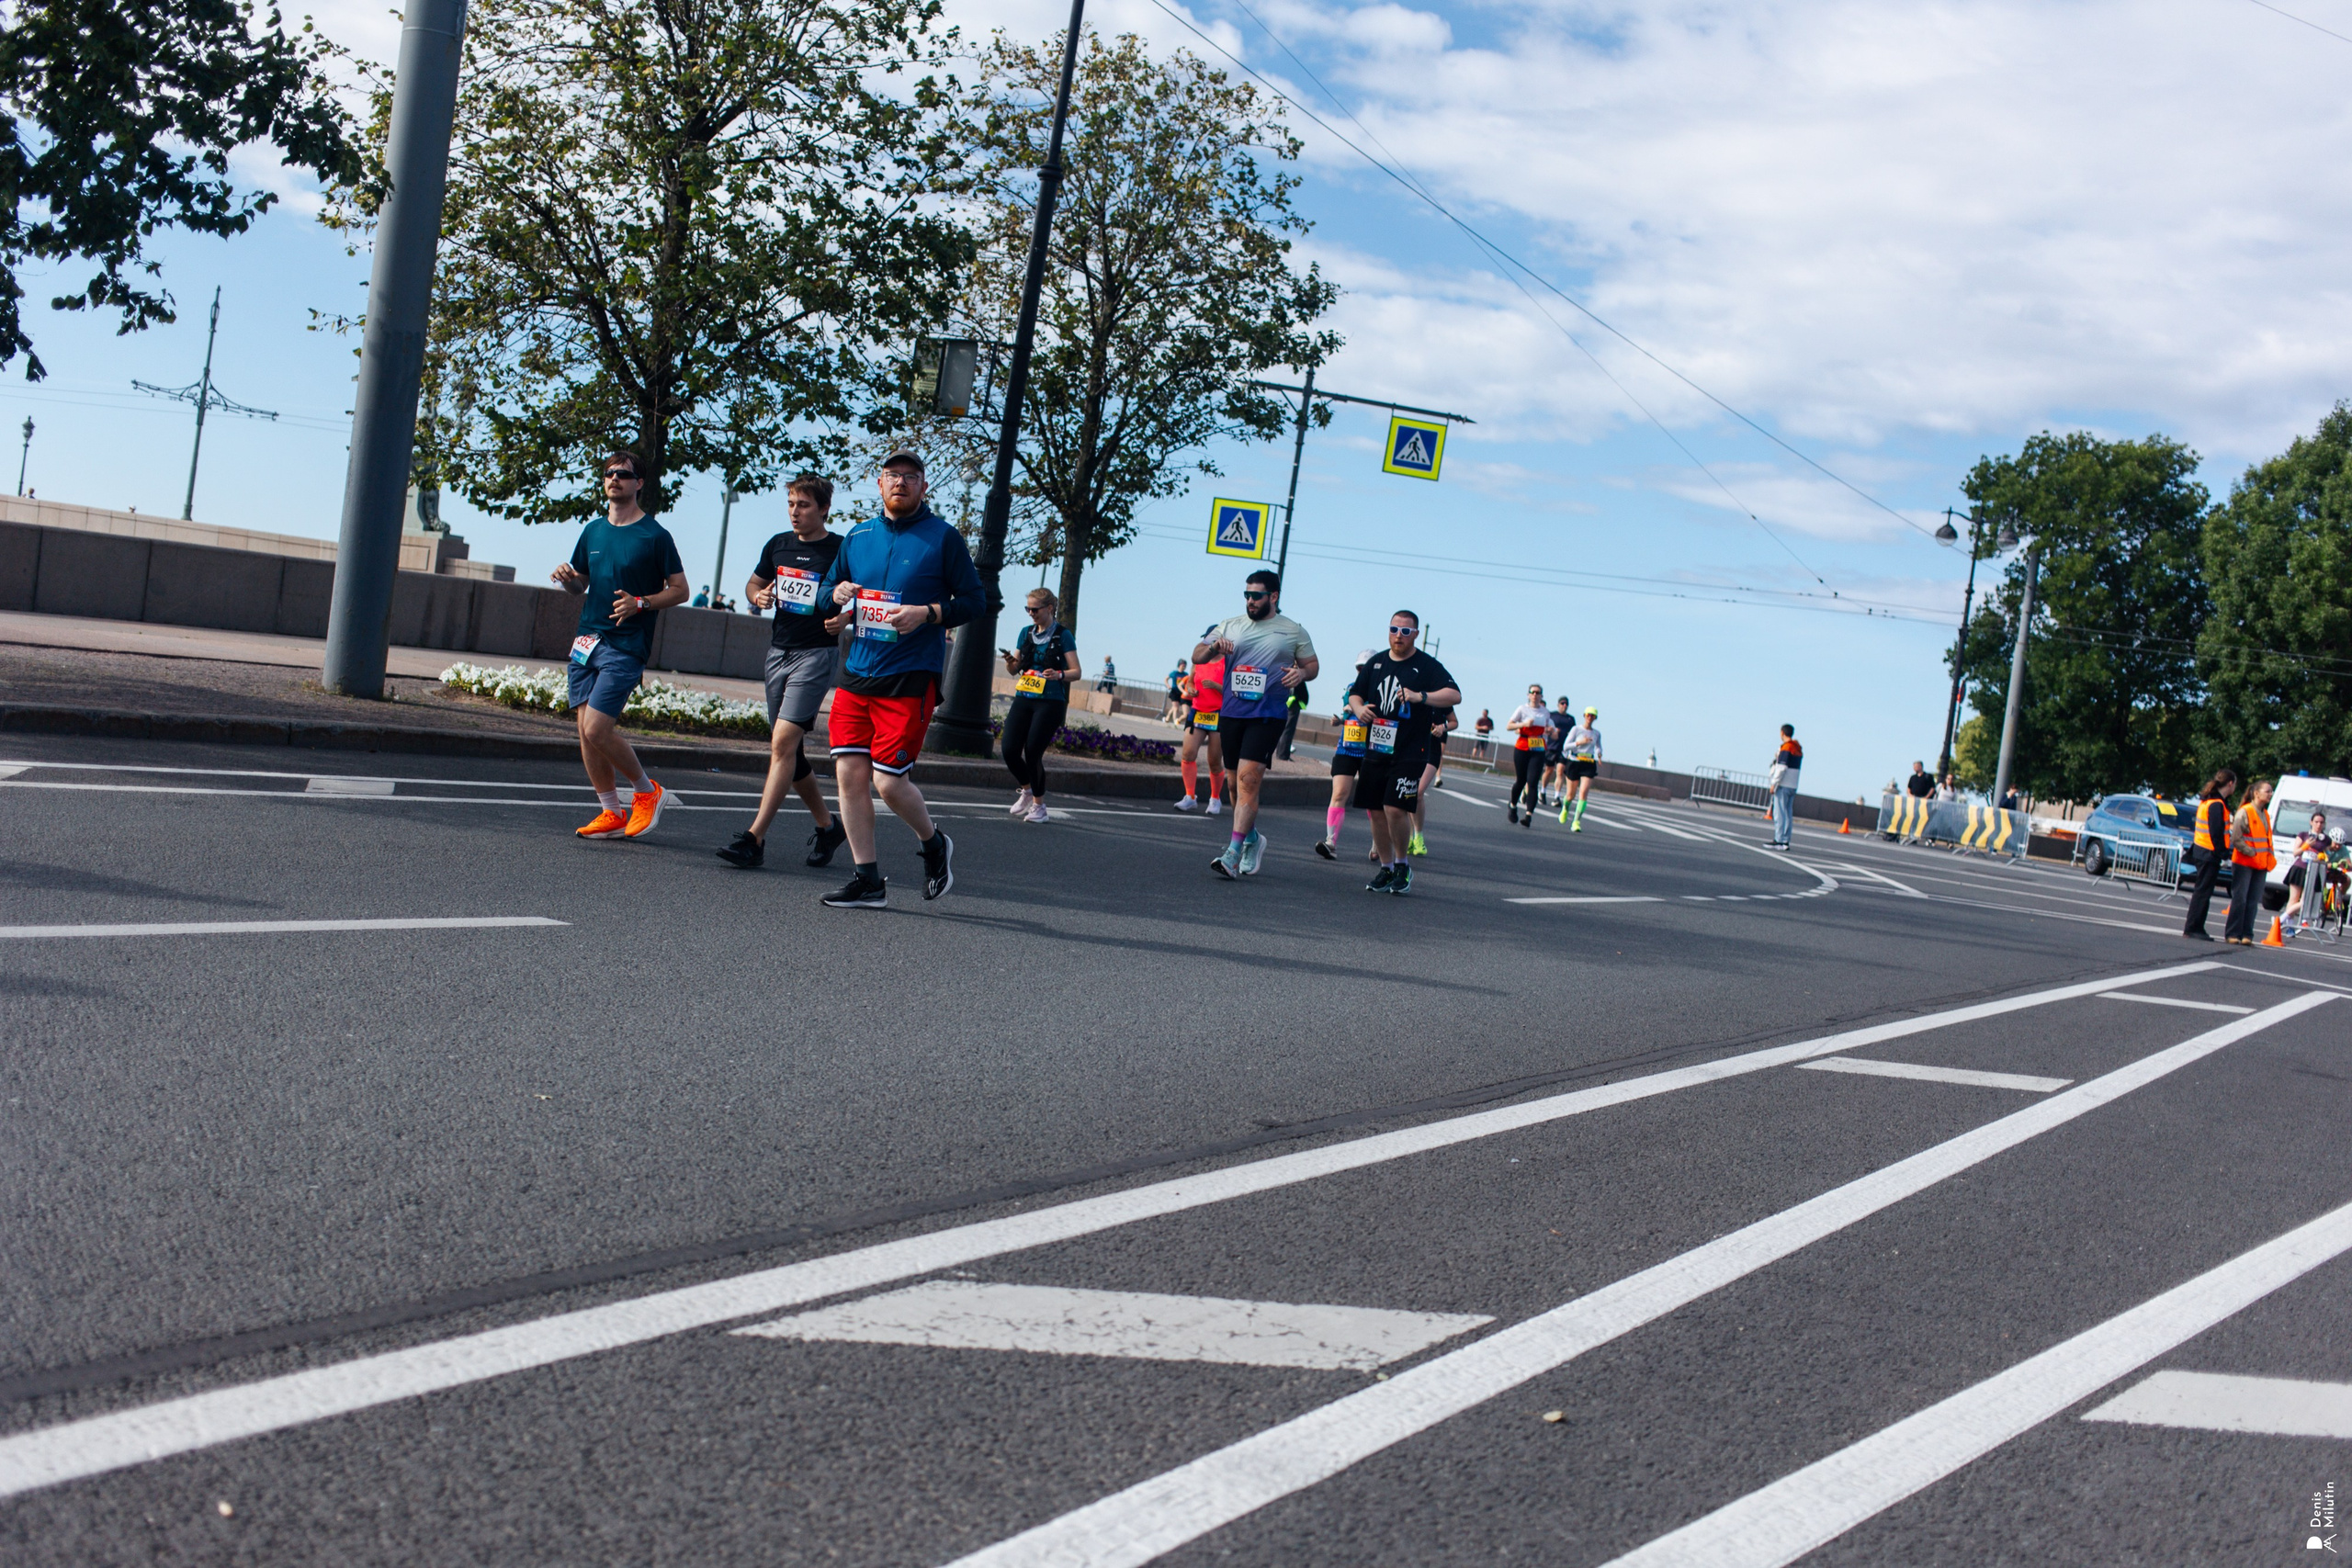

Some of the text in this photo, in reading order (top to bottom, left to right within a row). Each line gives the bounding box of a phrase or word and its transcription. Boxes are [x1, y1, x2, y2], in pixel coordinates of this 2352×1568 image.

[781, 580, 812, 597] 4672
[1021, 677, 1041, 688] 2436
[1235, 674, 1261, 686] 5625
[1348, 728, 1361, 737] 105
[1373, 728, 1391, 739] 5626
